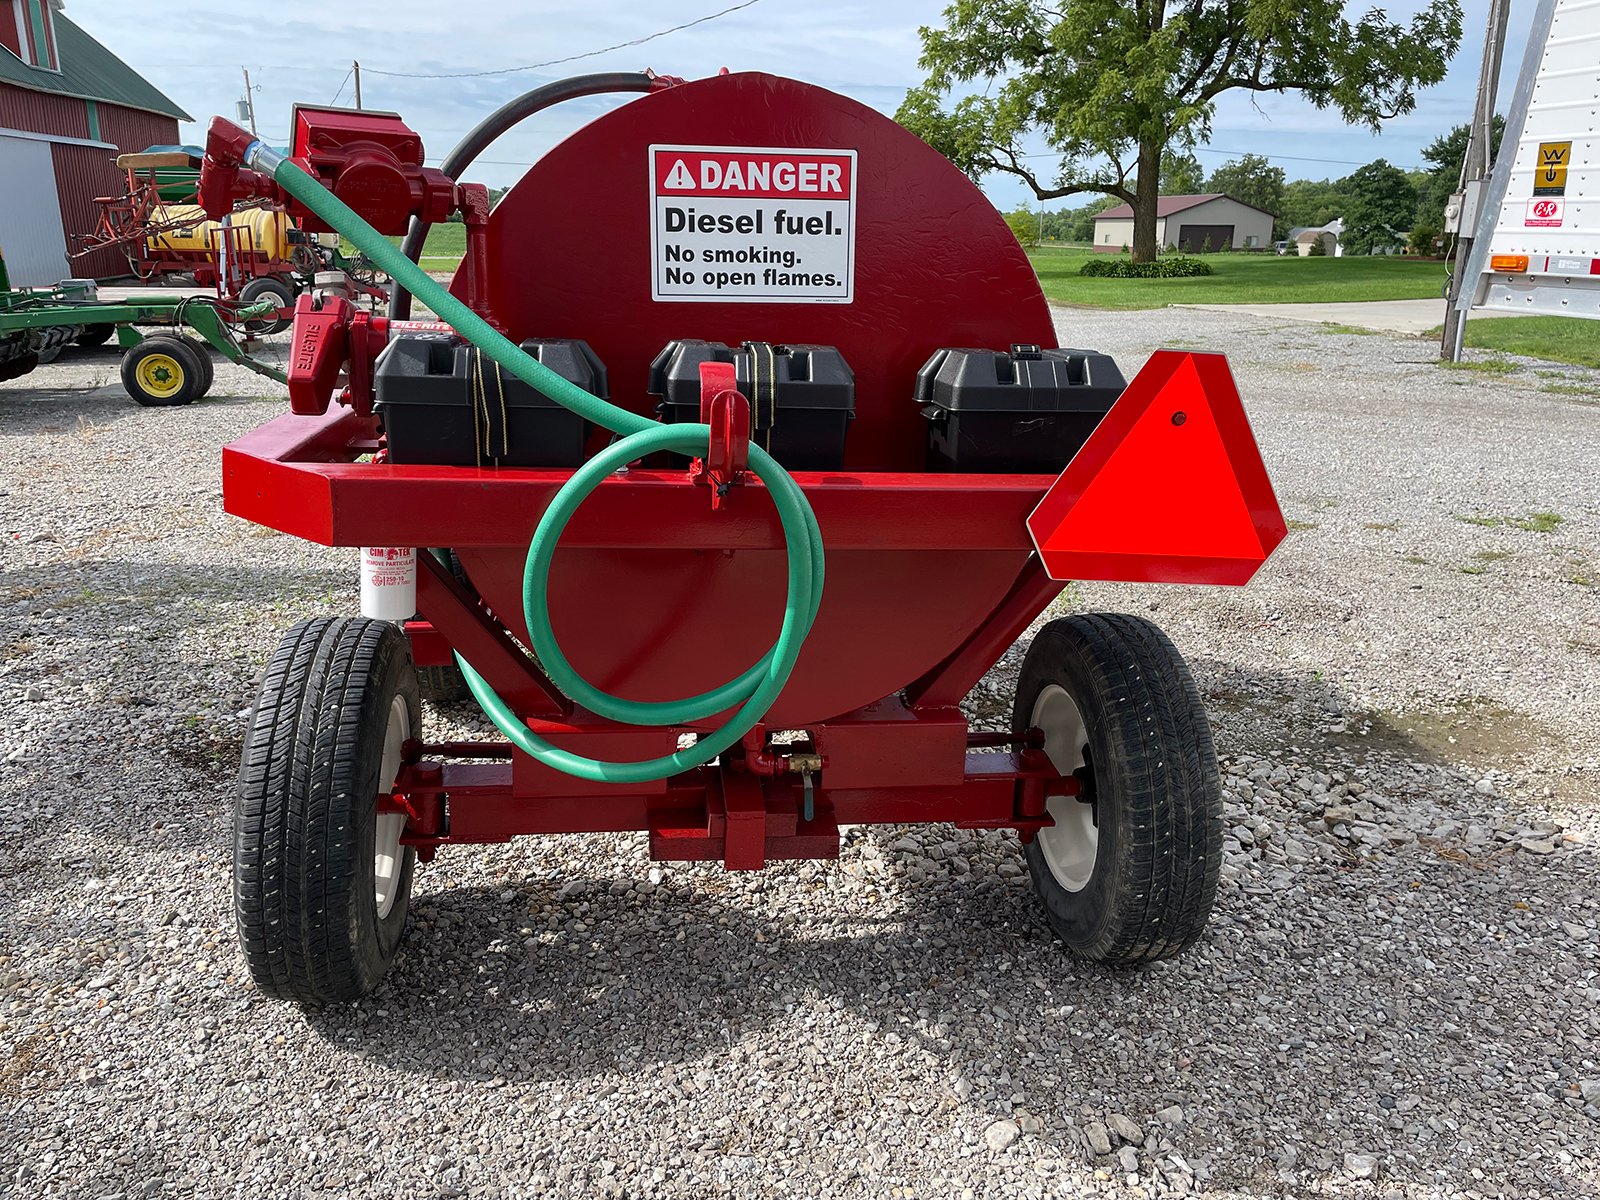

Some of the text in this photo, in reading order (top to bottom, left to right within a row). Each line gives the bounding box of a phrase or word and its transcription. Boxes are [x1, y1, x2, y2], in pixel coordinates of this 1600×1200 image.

[700, 160, 842, 193] DANGER
[665, 207, 842, 235] Diesel fuel.
[665, 244, 802, 268] No smoking.
[665, 267, 842, 289] No open flames.
[370, 548, 383, 556] CIM
